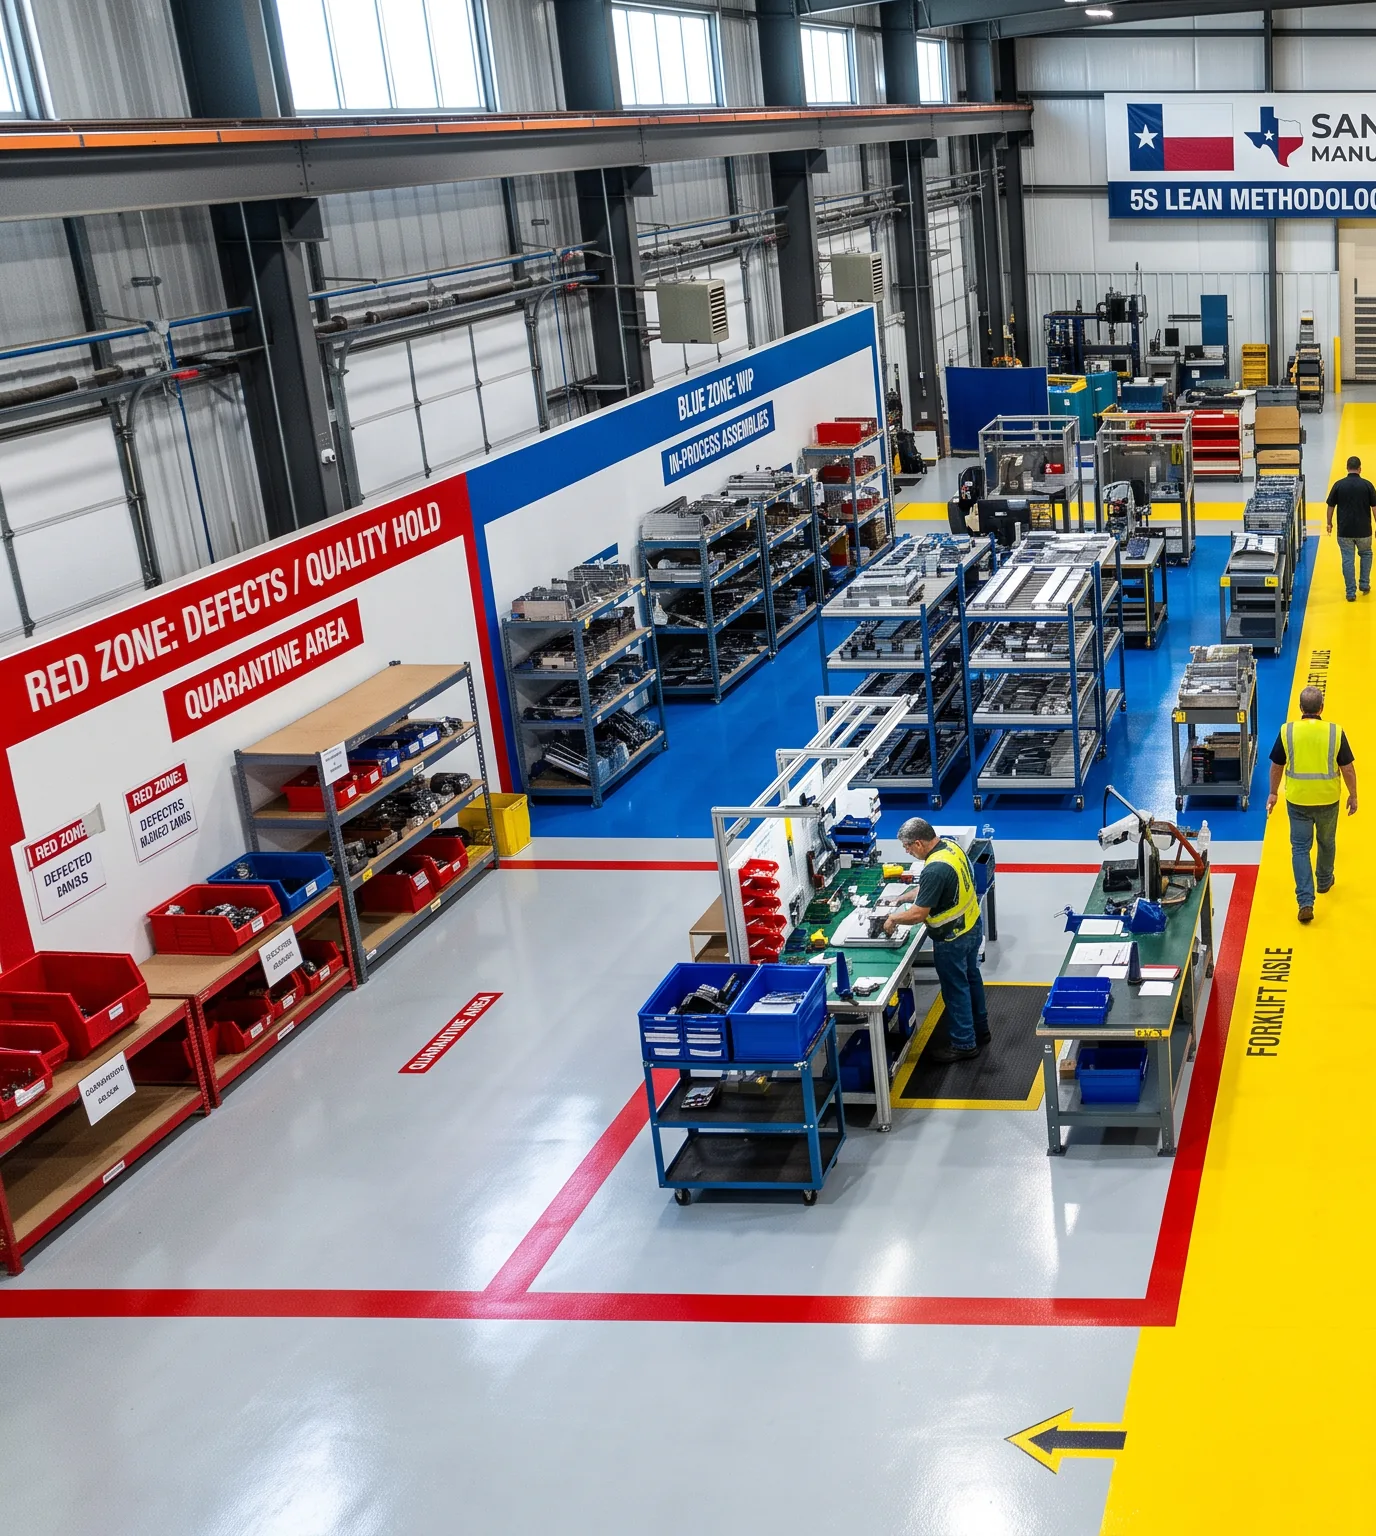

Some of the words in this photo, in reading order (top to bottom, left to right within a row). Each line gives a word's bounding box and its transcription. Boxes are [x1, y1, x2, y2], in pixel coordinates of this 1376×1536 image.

[1130, 188, 1159, 211] 5S
[1165, 188, 1223, 211] LEAN
[678, 388, 706, 421] BLUE
[707, 376, 736, 408] ZONE:
[736, 368, 754, 394] WIP
[669, 433, 721, 475] IN-PROCESS
[24, 654, 90, 713] RED
[95, 617, 179, 682] ZONE:
[182, 568, 288, 643] DEFECTS
[306, 522, 387, 587] QUALITY
[392, 502, 441, 548] HOLD
[185, 639, 303, 720] QUARANTINE
[306, 617, 350, 660] AREA
[132, 786, 153, 807] RED
[35, 838, 58, 862] RED
[43, 851, 93, 887] DEFECTED
[1259, 947, 1293, 983] AISLE
[1246, 986, 1288, 1057] FORKLIFT
